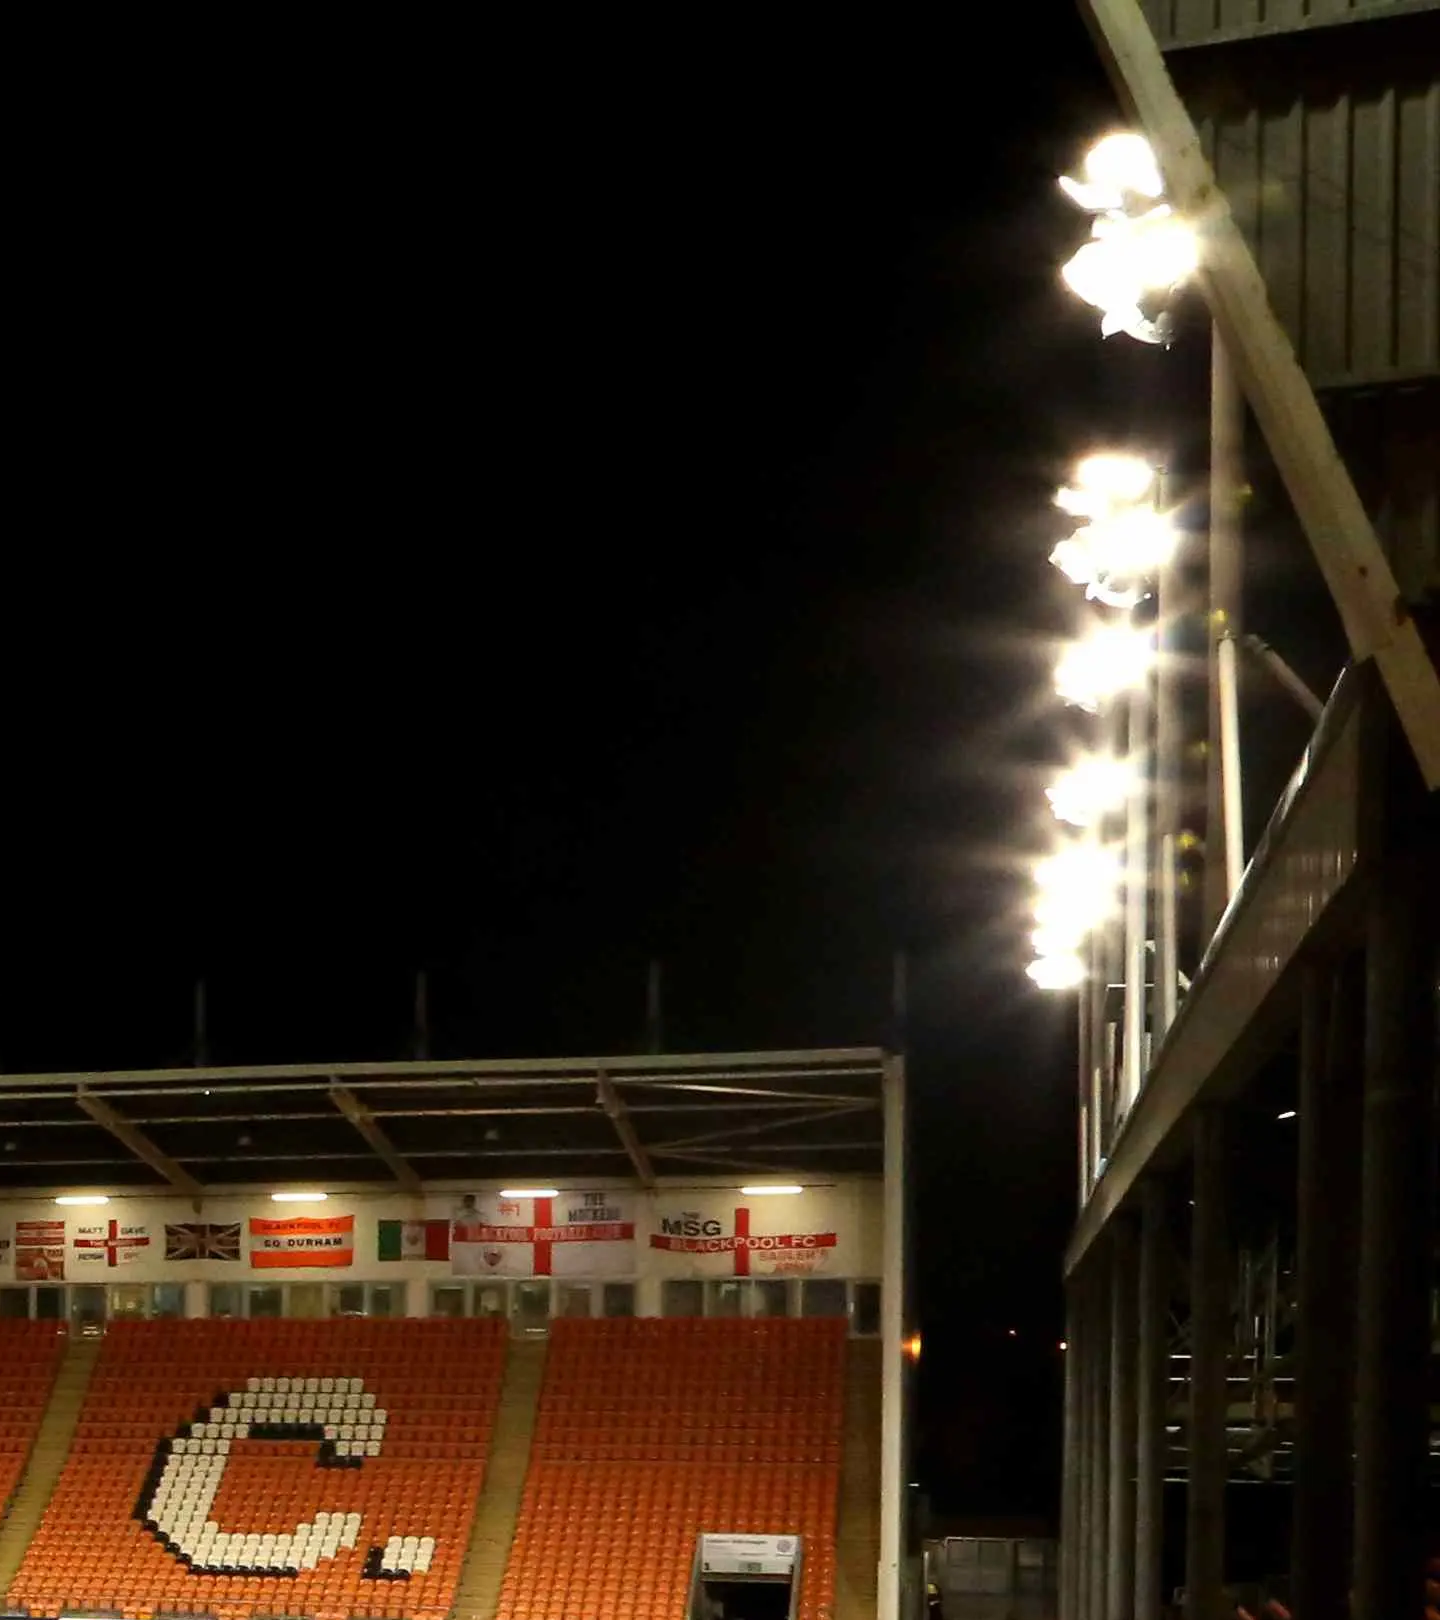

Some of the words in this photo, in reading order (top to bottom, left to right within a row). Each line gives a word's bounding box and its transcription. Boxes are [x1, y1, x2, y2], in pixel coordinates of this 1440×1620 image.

[662, 1218, 722, 1236] MSG
[287, 1238, 343, 1247] DURHAM
[670, 1236, 785, 1252] BLACKPOOL
[791, 1236, 816, 1248] FC
